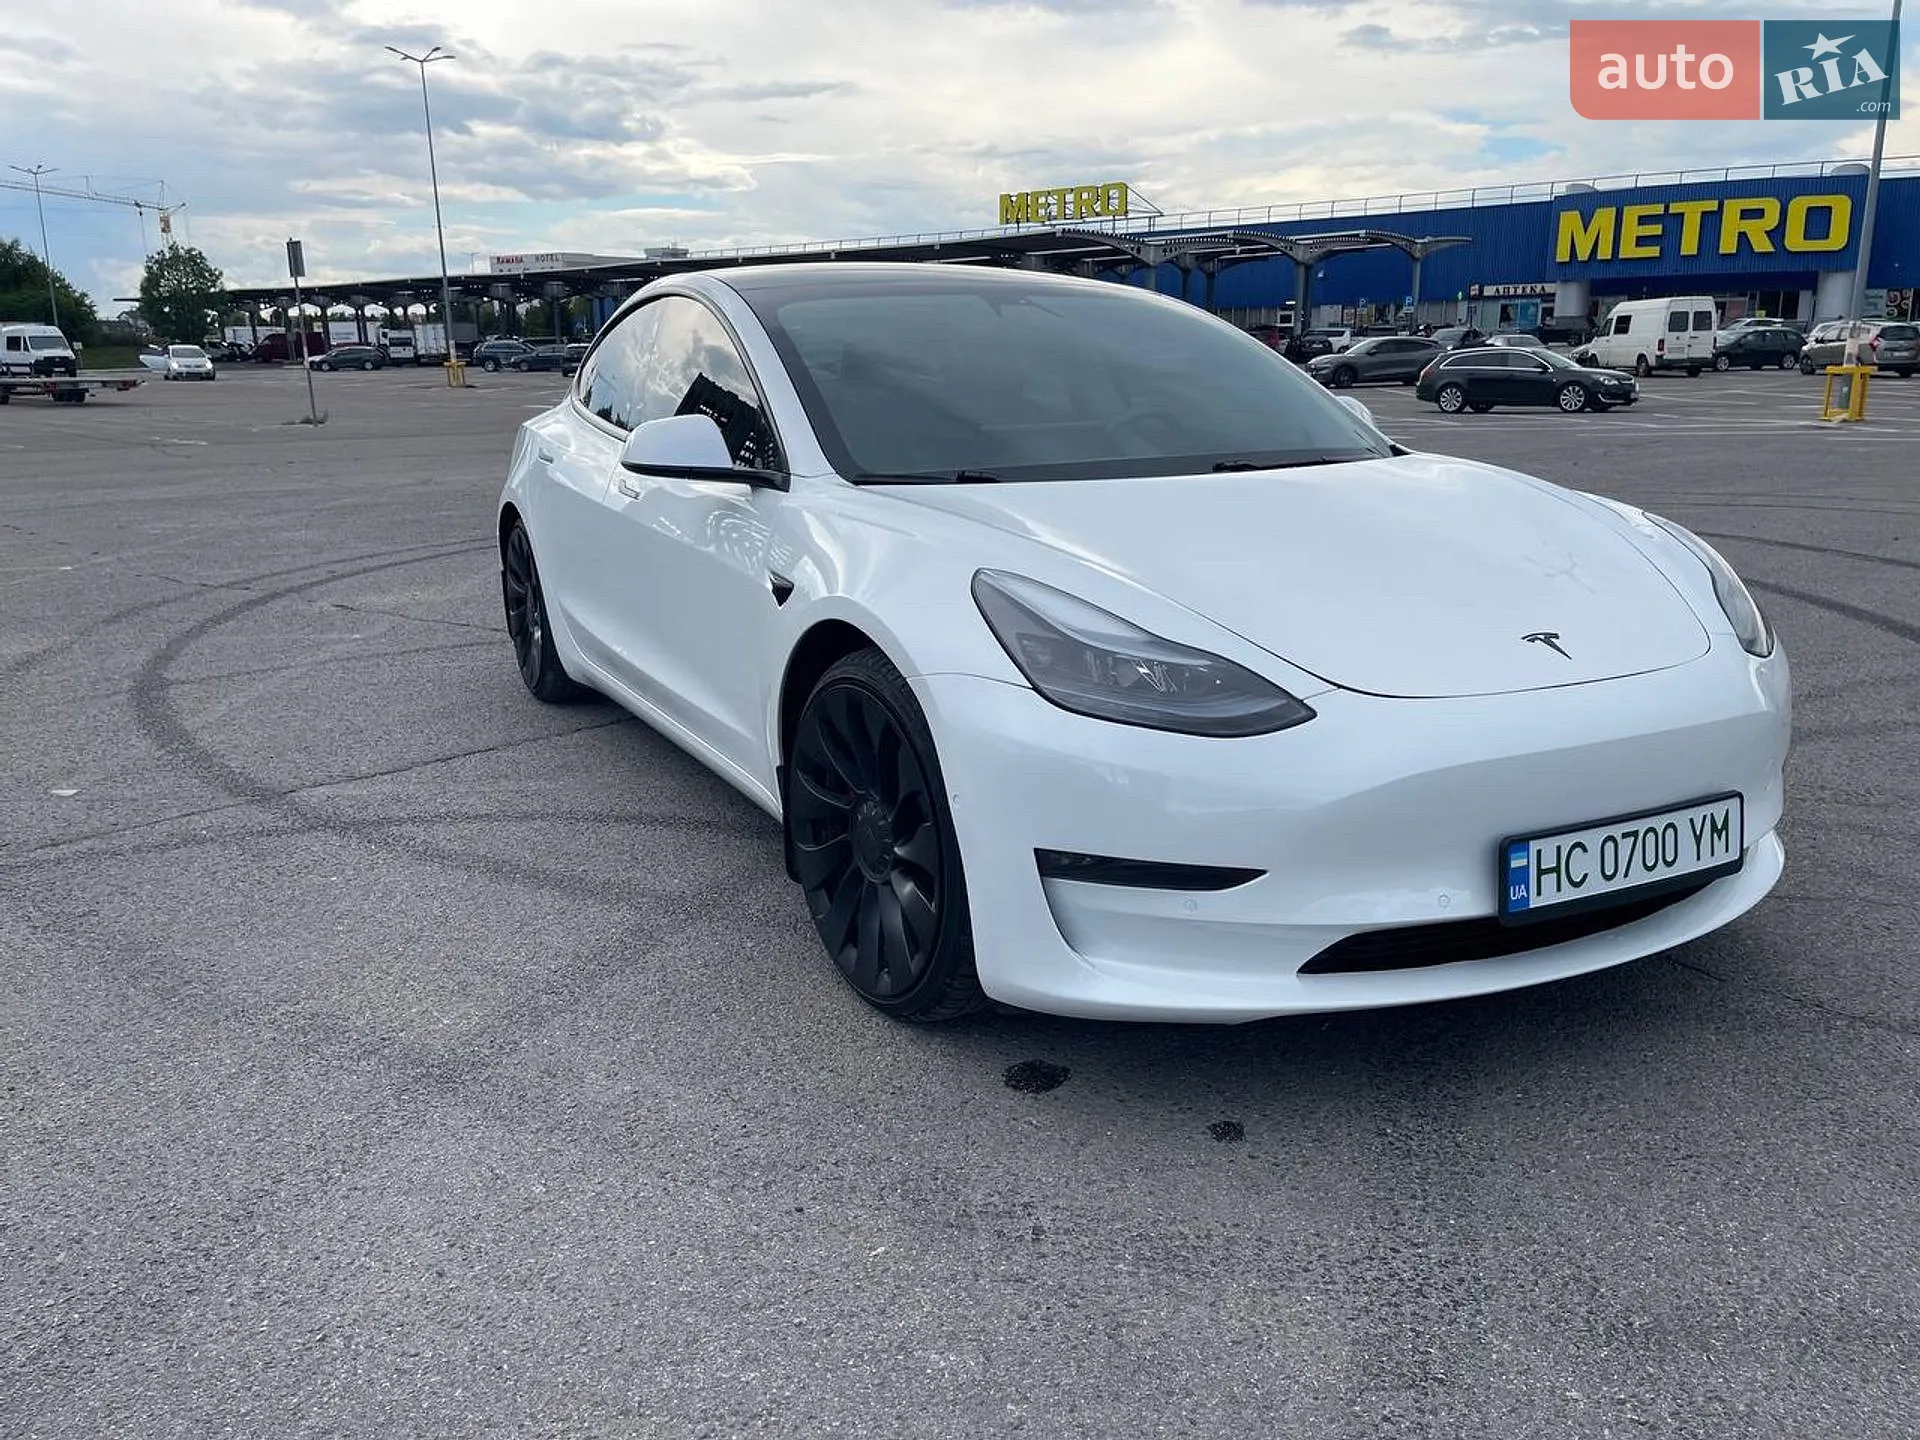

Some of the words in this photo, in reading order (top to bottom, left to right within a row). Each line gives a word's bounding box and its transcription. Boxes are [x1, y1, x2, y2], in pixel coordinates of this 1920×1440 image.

[999, 182, 1128, 225] METRO
[1556, 194, 1853, 263] METRO
[1536, 841, 1589, 897] HC
[1600, 822, 1678, 882] 0700
[1689, 807, 1730, 862] YM
[1510, 885, 1528, 900] UA
